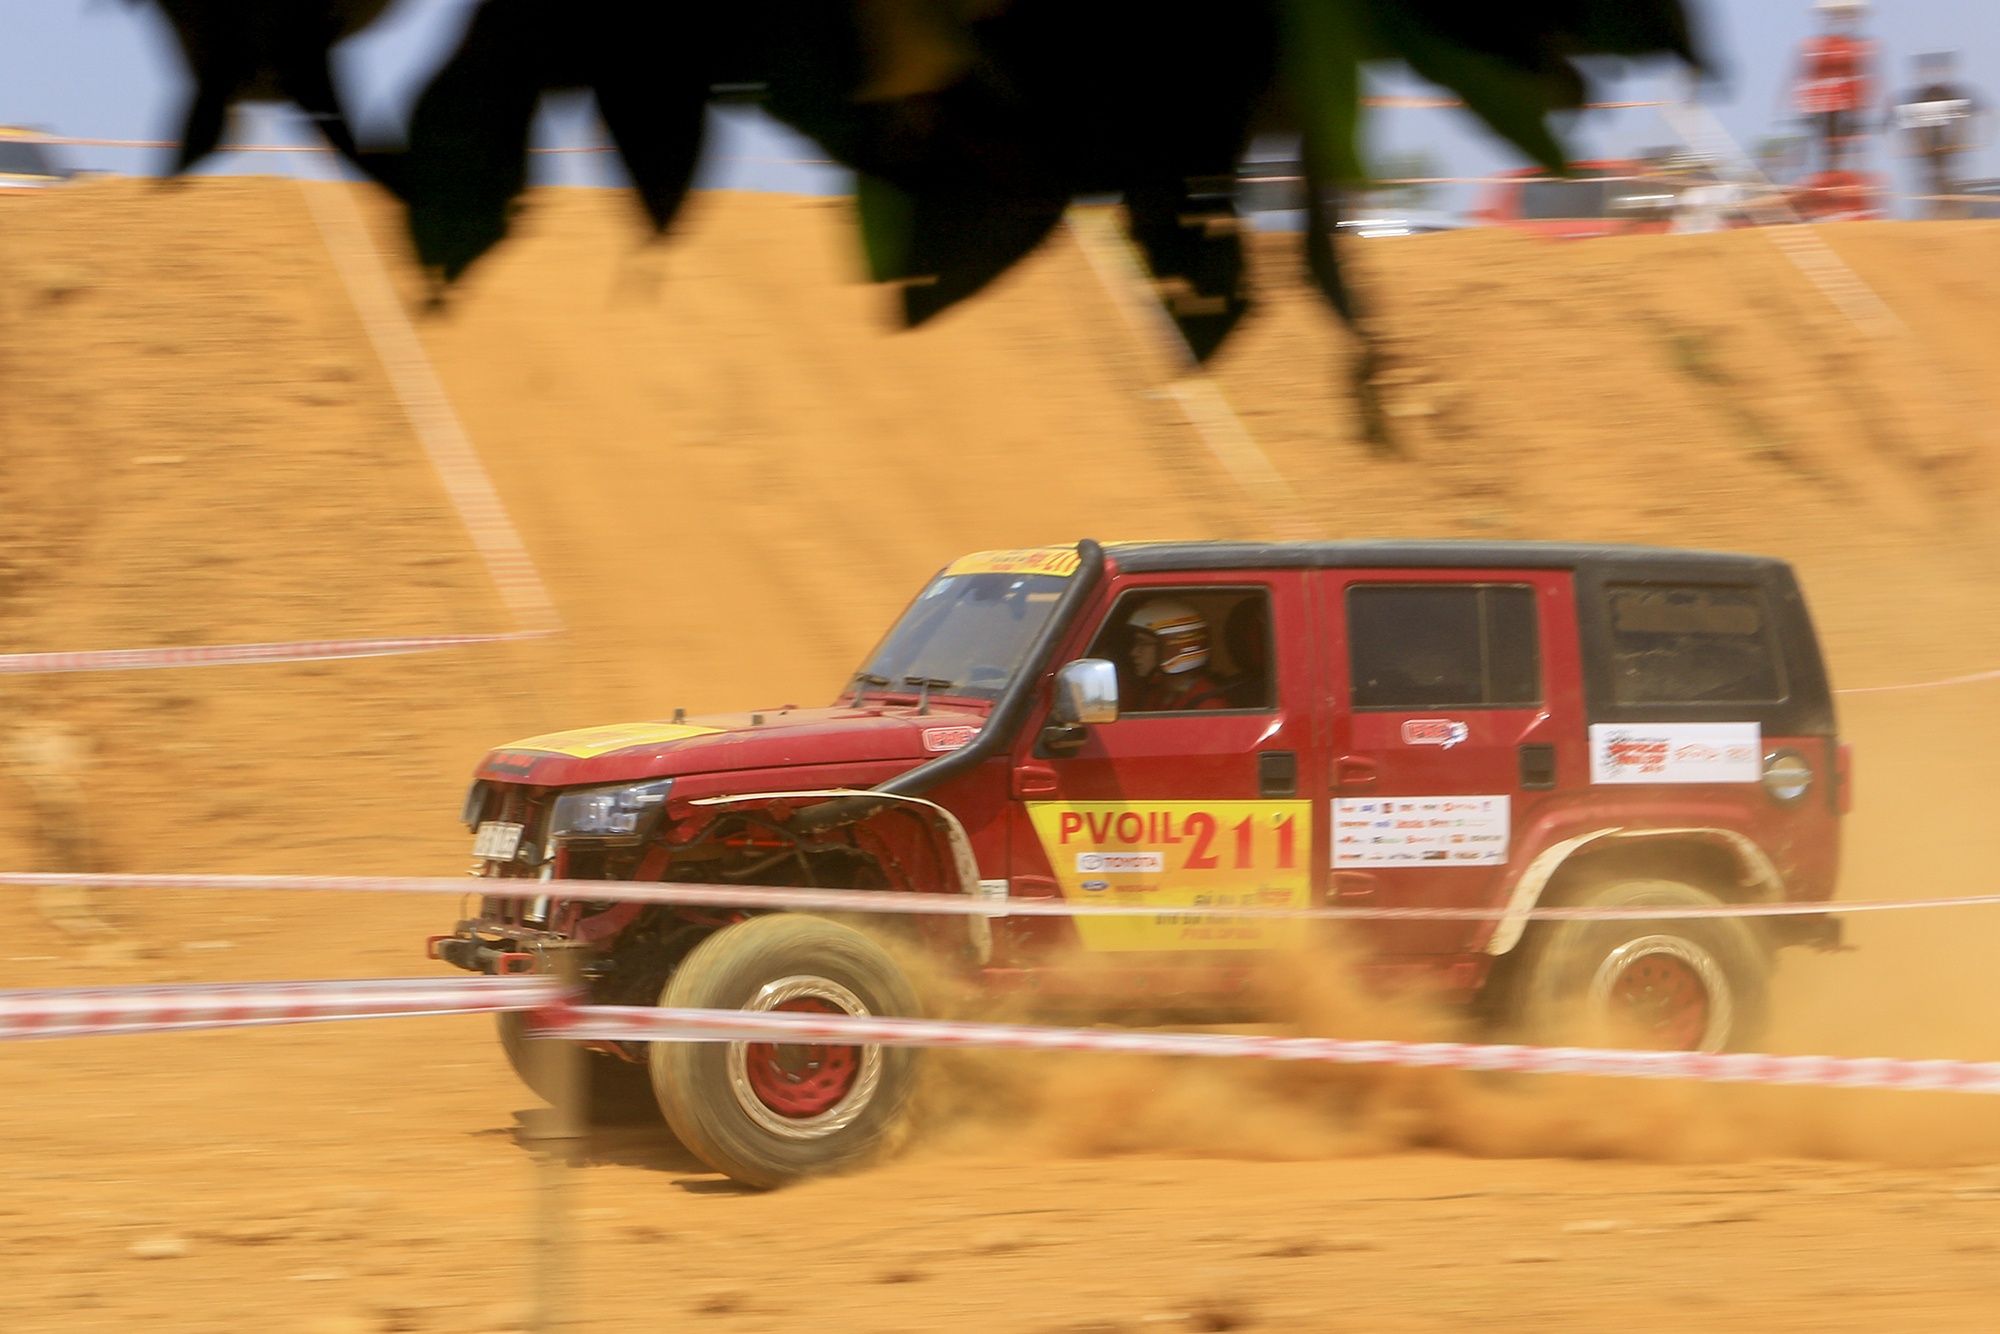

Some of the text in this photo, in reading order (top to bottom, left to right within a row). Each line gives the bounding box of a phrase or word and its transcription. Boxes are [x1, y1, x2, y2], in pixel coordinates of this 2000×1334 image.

[1060, 811, 1298, 870] PVOIL 211
[1103, 856, 1160, 868] TOYOTA
